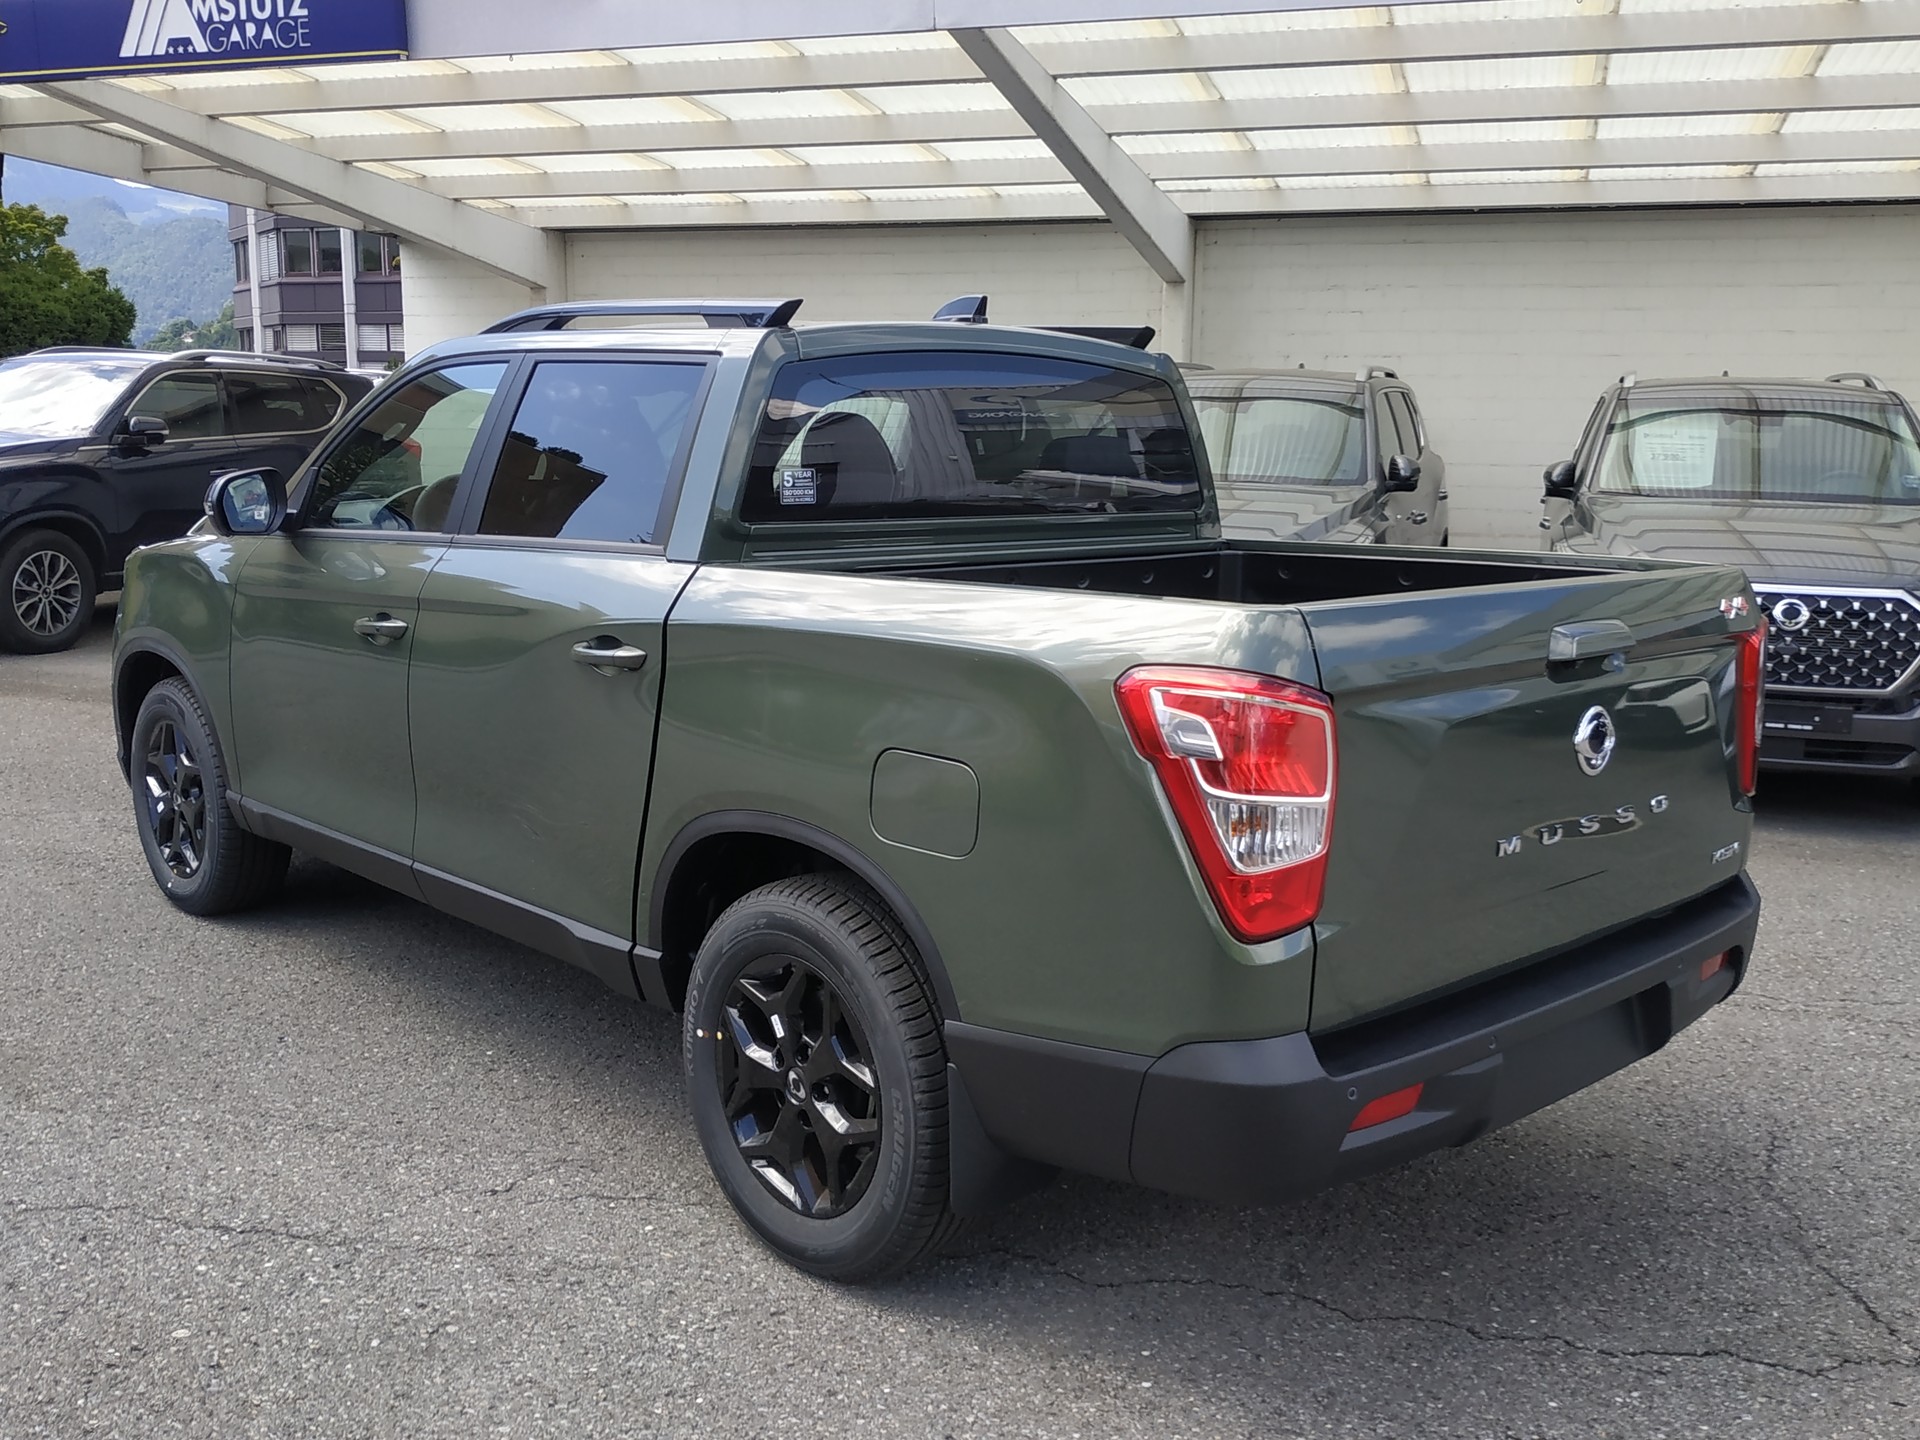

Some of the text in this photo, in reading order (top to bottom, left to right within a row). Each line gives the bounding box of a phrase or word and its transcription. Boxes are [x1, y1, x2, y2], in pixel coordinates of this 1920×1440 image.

[206, 18, 311, 53] GARAGE
[783, 471, 793, 487] 5
[1496, 794, 1669, 857] MUSSO
[686, 989, 699, 1077] KUMHO
[881, 1087, 904, 1212] CRUGEN
